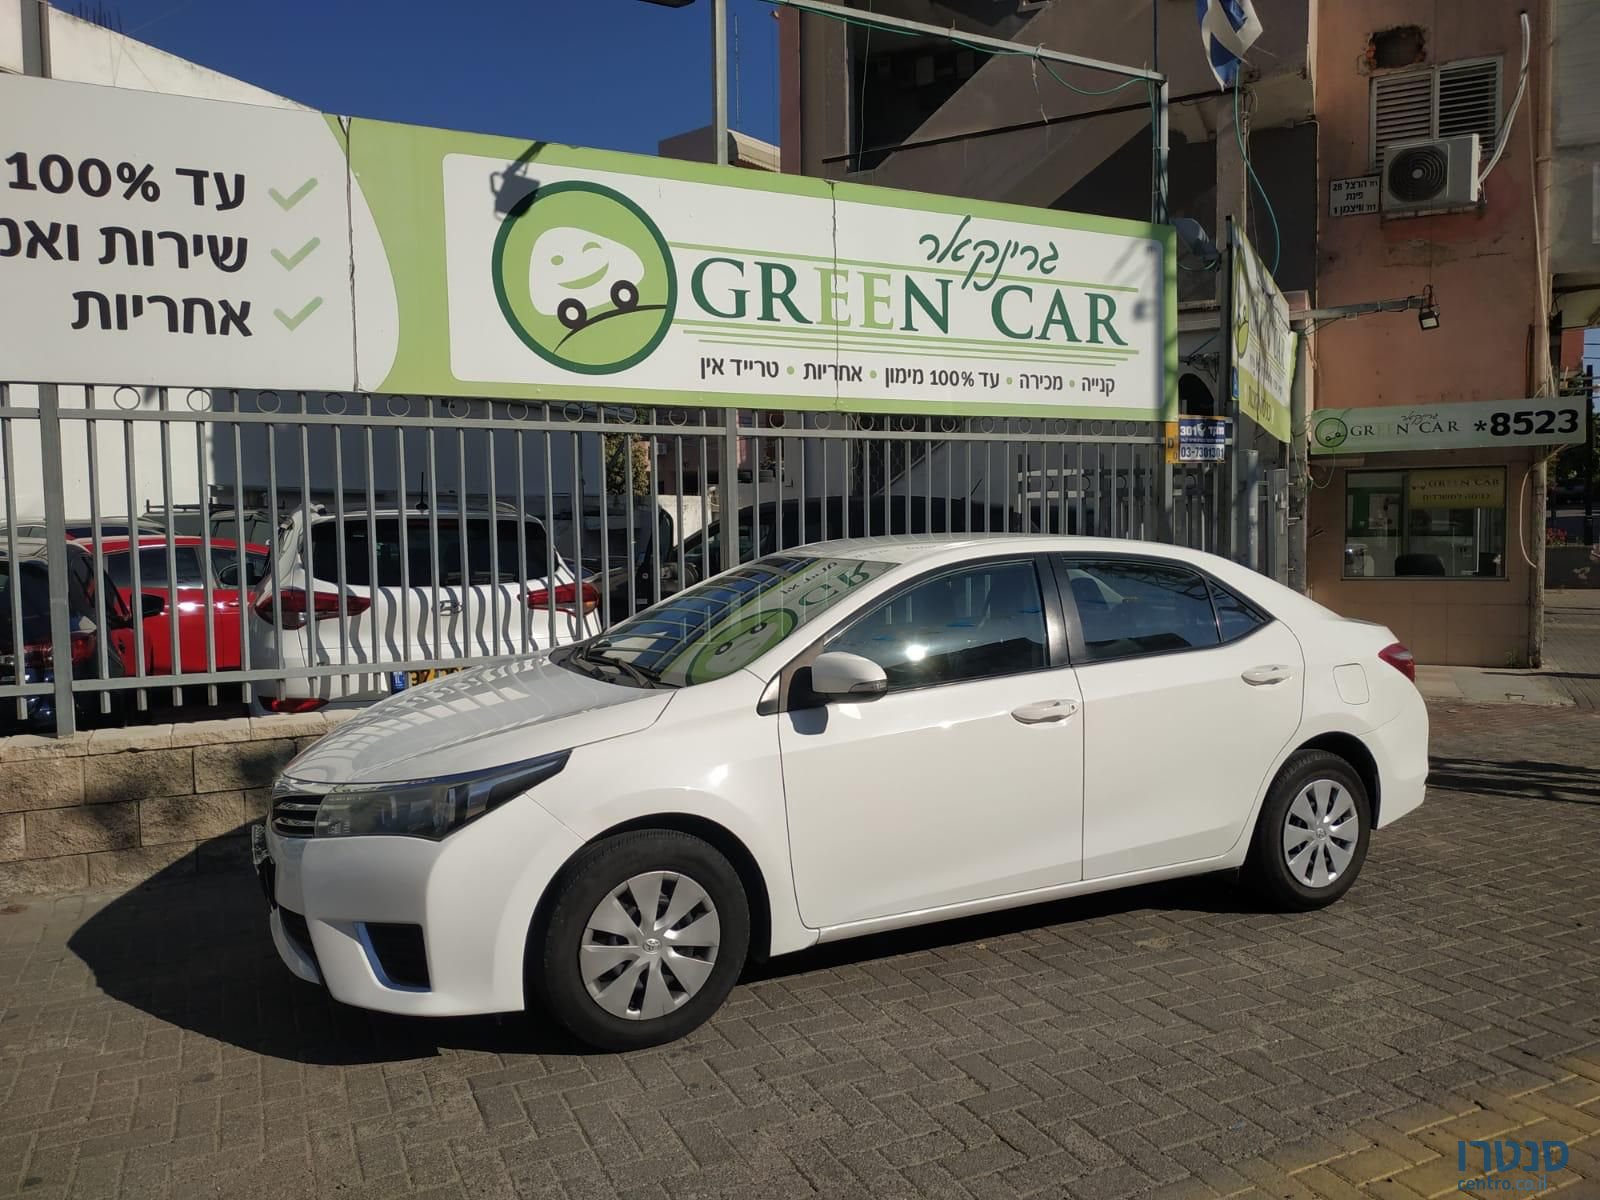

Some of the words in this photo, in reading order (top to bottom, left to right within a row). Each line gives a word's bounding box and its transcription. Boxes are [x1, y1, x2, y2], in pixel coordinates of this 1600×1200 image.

[5, 151, 161, 203] 100%
[175, 167, 245, 211] עד
[98, 226, 248, 273] שירות
[919, 214, 1059, 291] גרינקאר
[690, 257, 953, 334] GREEN
[991, 284, 1128, 346] CAR
[71, 290, 253, 337] אחריות
[700, 357, 725, 380] אין
[729, 358, 779, 378] טרייד
[803, 362, 863, 382] אחריות
[885, 367, 924, 388] מימון
[929, 369, 975, 387] 100%
[978, 371, 1000, 389] עד
[1019, 373, 1063, 391] מכירה
[1081, 376, 1115, 397] קנייה
[1180, 425, 1198, 437] 301
[1419, 420, 1460, 433] CAR
[1428, 479, 1470, 488] GRN
